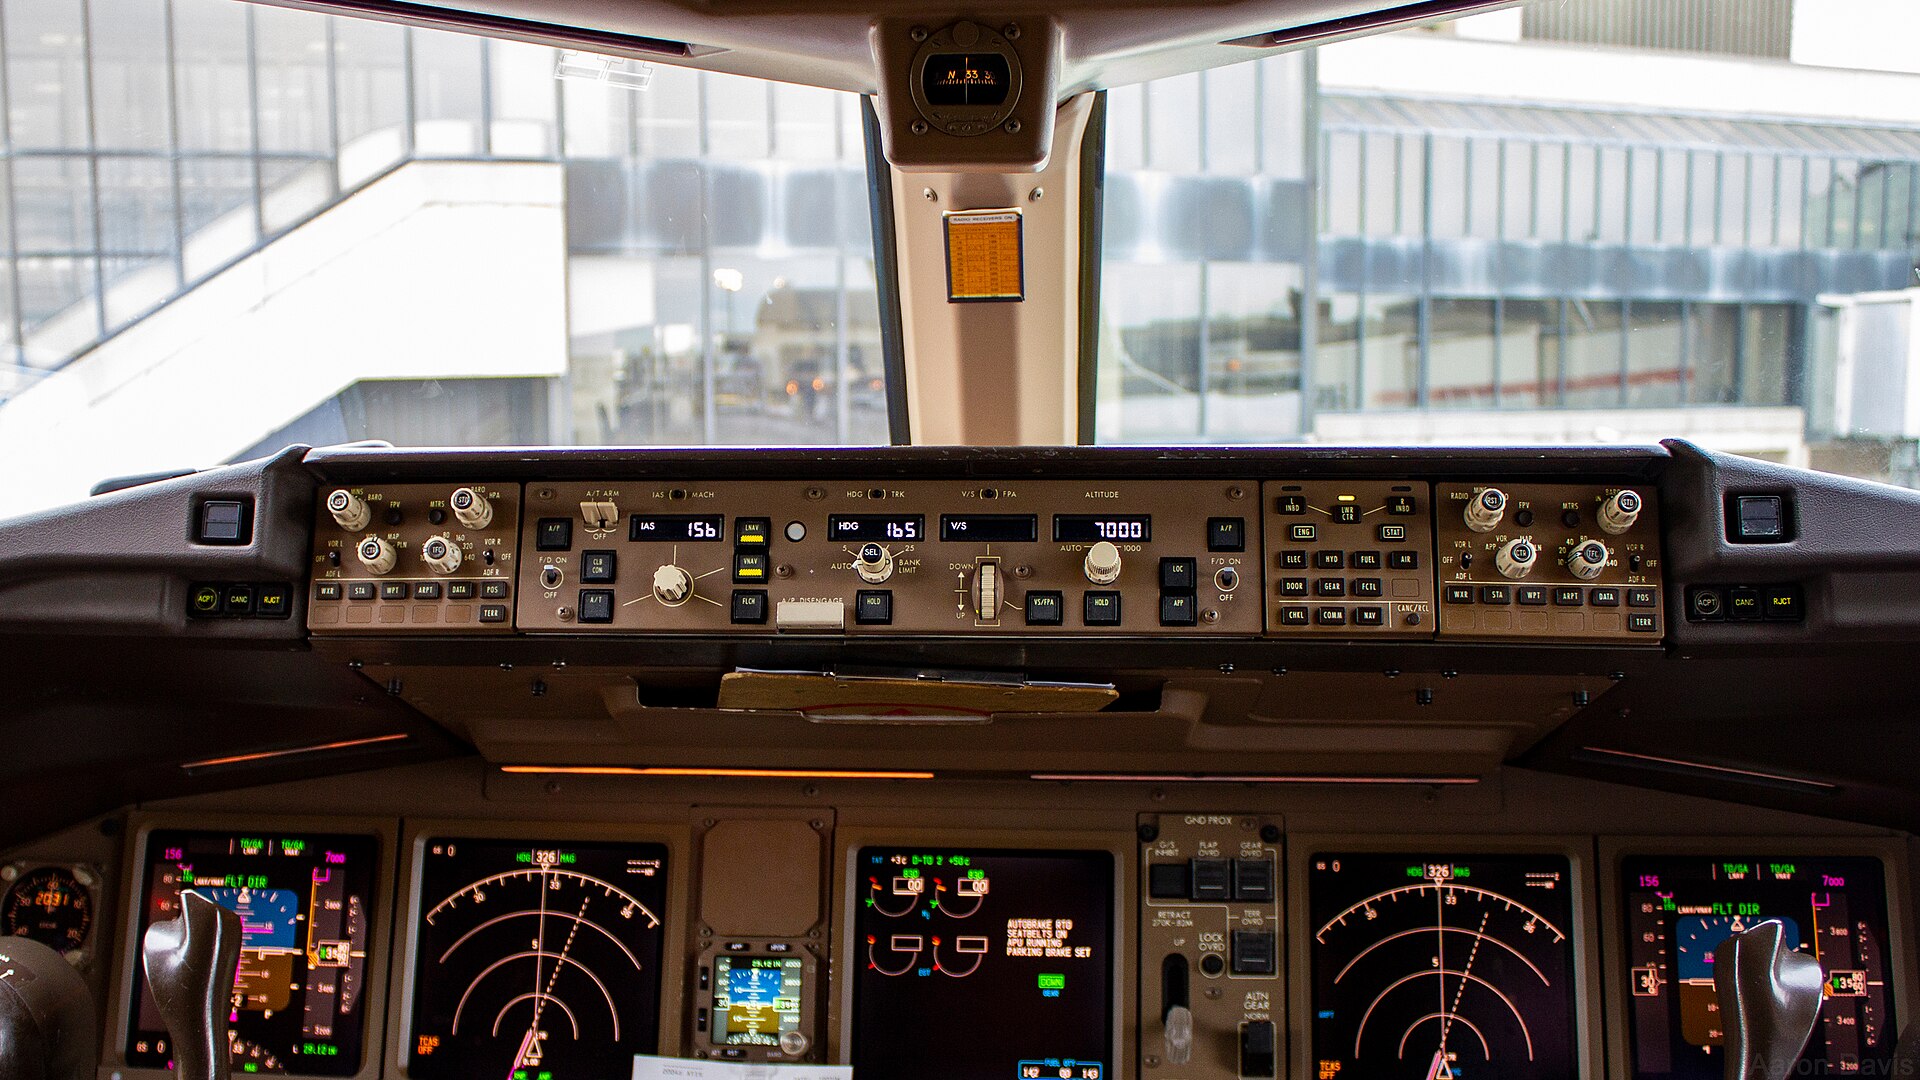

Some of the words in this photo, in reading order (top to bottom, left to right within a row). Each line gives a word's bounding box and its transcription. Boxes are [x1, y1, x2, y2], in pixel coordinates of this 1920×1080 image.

[966, 70, 978, 79] 33
[846, 490, 864, 498] HDG
[891, 490, 905, 498] TRK
[961, 490, 975, 498] V/S
[1002, 490, 1017, 498] FPA
[1450, 492, 1469, 500] RADIO
[430, 500, 446, 508] MTRS
[1562, 502, 1579, 510] MTRS
[640, 522, 655, 531] IAS
[745, 524, 760, 532] LNAV
[838, 522, 859, 530] HDG
[951, 522, 967, 531] V/S
[1094, 521, 1142, 538] 7000
[1220, 524, 1232, 532] A/P
[1298, 528, 1310, 536] ENG
[1386, 528, 1400, 536] STAT
[1495, 534, 1508, 542] VOR
[1566, 538, 1575, 546] 40
[1060, 544, 1082, 552] AUTO
[1123, 544, 1142, 552] 1000
[1484, 543, 1497, 551] APP
[1558, 546, 1567, 554] 20
[864, 548, 878, 556] SEL
[743, 558, 758, 566] VNAV
[1287, 555, 1301, 563] ELEC
[1360, 556, 1375, 564] FUEL
[1442, 556, 1454, 564] OFF
[1646, 560, 1657, 568] OFF
[592, 566, 603, 574] CON
[898, 566, 916, 574] LIMIT
[1172, 565, 1183, 573] LOC
[1455, 572, 1467, 580] ADF
[386, 586, 399, 594] WPT
[418, 586, 433, 594] ARPT
[452, 586, 466, 594] DATA
[486, 586, 498, 594] POS
[1286, 582, 1303, 590] DOOR
[1324, 582, 1341, 590] GEAR
[1361, 583, 1377, 591] FCTL
[320, 587, 334, 595] WXR
[354, 587, 365, 595] STA
[1453, 591, 1469, 599] WXR
[1491, 591, 1504, 599] STA
[1218, 594, 1234, 602] OFF
[1526, 591, 1541, 600] WPT
[1562, 592, 1579, 600] ARPT
[1598, 592, 1614, 601] DATA
[1636, 594, 1650, 602] POS
[230, 596, 248, 604] CANC
[263, 596, 280, 604] RJCT
[866, 597, 881, 605] HOLD
[1033, 598, 1054, 606] VS/FPA
[1094, 598, 1109, 606] HOLD
[1173, 599, 1184, 607] APP
[1735, 598, 1755, 606] CANC
[1773, 597, 1792, 605] RJCT
[1397, 604, 1429, 612] CANC/RCL
[1288, 611, 1304, 619] CHKL
[1323, 611, 1343, 619] COMM
[1363, 611, 1376, 619] NAV
[1636, 618, 1652, 626] TERR
[1184, 816, 1207, 825] GND
[1208, 816, 1232, 825] PROX
[1240, 842, 1262, 850] GEAR
[164, 848, 183, 860] 156
[325, 851, 346, 864] 7000
[536, 850, 556, 863] 326
[560, 852, 576, 864] MAG
[1406, 866, 1424, 877] HDG
[1428, 864, 1450, 878] 326
[1723, 863, 1748, 874] TO/GA
[1770, 863, 1796, 874] TO/GA
[224, 874, 244, 888] FLT
[248, 875, 268, 889] DIR
[1639, 874, 1659, 888] 156
[1822, 875, 1845, 887] 7000
[549, 880, 562, 891] 33
[1444, 895, 1457, 906] 33
[1712, 902, 1733, 915] FLT
[1738, 903, 1760, 915] DIR
[1158, 911, 1191, 919] RETRACT
[1244, 910, 1261, 918] TERR
[1364, 909, 1378, 920] 30
[1007, 918, 1053, 930] AUTOBRAKE
[1055, 919, 1073, 930] RTO
[1241, 918, 1263, 926] OVRD
[1007, 929, 1053, 939] SEATBELTS
[1055, 929, 1068, 939] ON
[1198, 933, 1224, 943] LOCK
[1007, 938, 1024, 948] APU
[1026, 938, 1062, 948] RUNNING
[1173, 939, 1185, 947] UP
[1198, 942, 1225, 952] OVRD
[1006, 947, 1043, 957] PARKING
[1045, 948, 1072, 958] BRAKE
[1074, 948, 1091, 958] SET
[1245, 992, 1269, 1001] ALTN
[1244, 1002, 1270, 1010] GEAR
[419, 1034, 440, 1047] TCAS
[418, 1046, 433, 1055] OFF
[1319, 1060, 1341, 1072] TCAS
[1319, 1070, 1336, 1080] OFF
